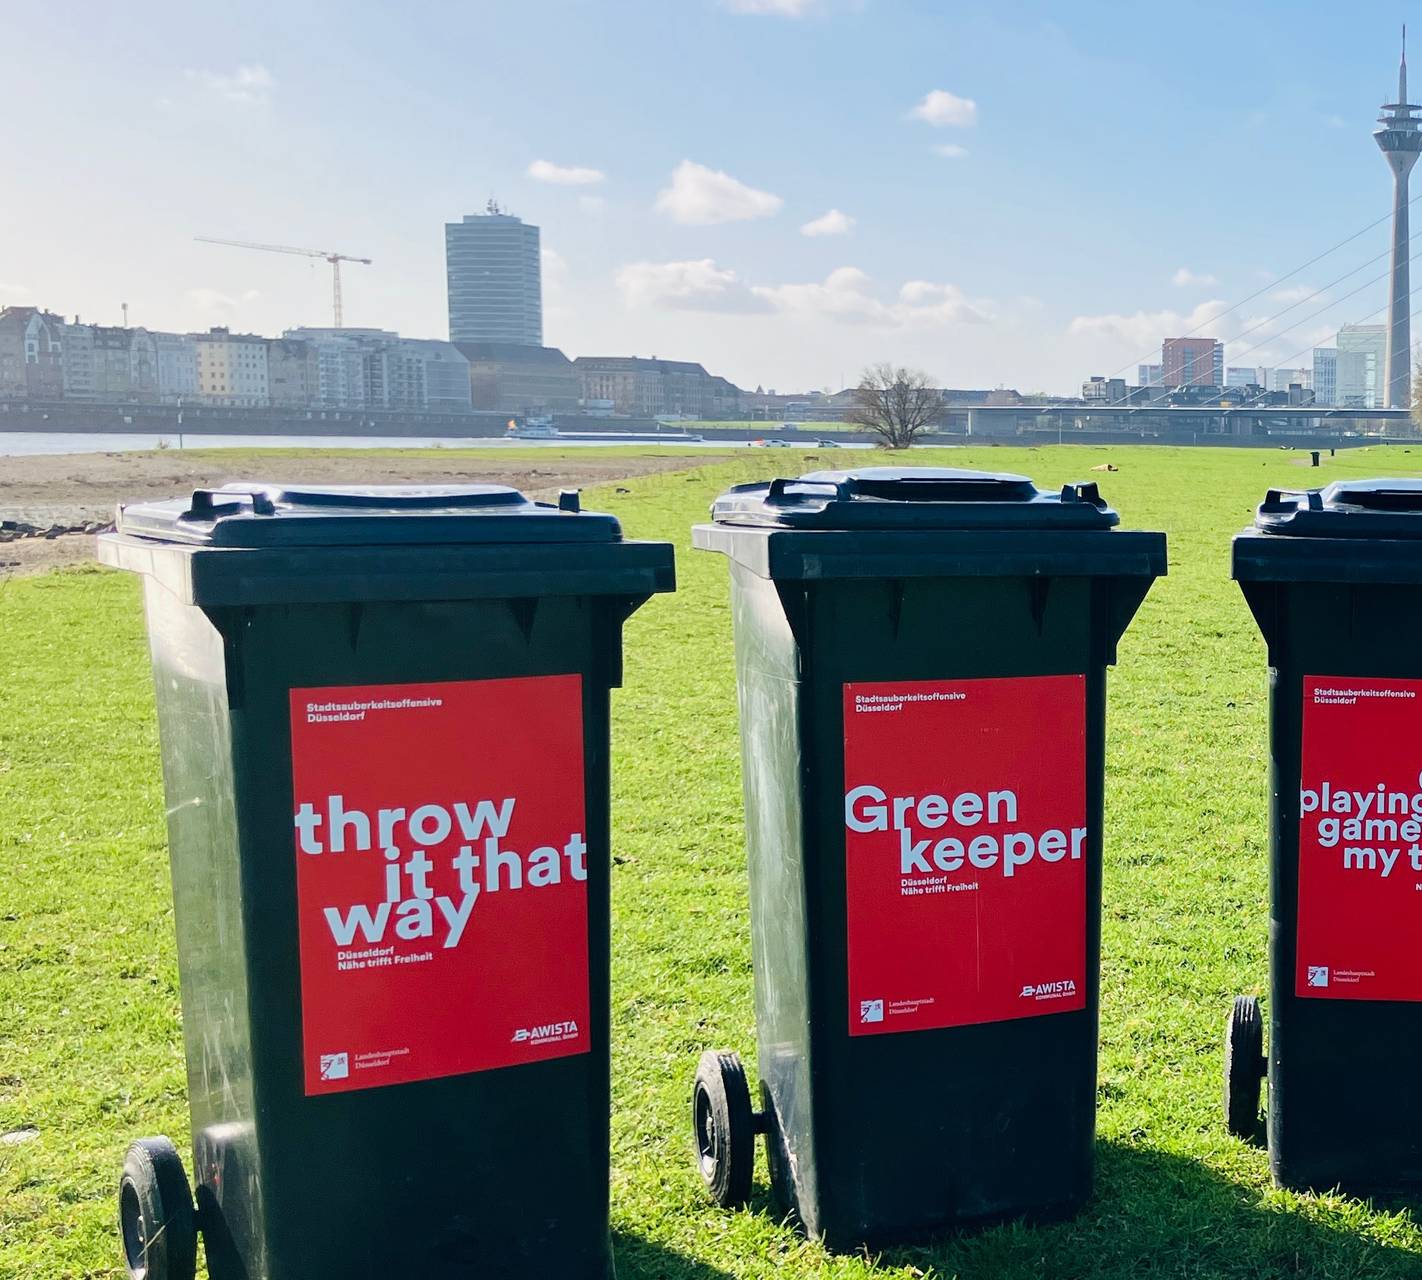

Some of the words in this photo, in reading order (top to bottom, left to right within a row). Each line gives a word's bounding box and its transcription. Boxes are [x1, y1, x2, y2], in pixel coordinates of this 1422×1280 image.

[856, 692, 966, 703] Stadtsauberkeitsoffensive
[1314, 688, 1415, 697] Stadtsauberkeitsoffensive
[307, 699, 442, 712] Stadtsauberkeitsoffensive
[1314, 696, 1356, 704] Düsseldorf
[856, 702, 903, 712] Düsseldorf
[307, 711, 365, 723] Düsseldorf
[845, 785, 1017, 833] Green
[294, 795, 515, 854] throw
[901, 826, 1087, 877] keeper
[386, 845, 433, 903] it
[453, 833, 587, 896] that
[1344, 847, 1400, 877] my
[901, 875, 947, 886] Düsseldorf
[901, 886, 924, 895] Nähe
[925, 884, 945, 894] trifft
[947, 882, 978, 892] Freiheit
[324, 890, 480, 948] way
[338, 946, 394, 960] Düsseldorf
[338, 959, 365, 970] Nähe
[367, 956, 392, 967] trifft
[394, 952, 433, 964] Freiheit
[1036, 981, 1075, 994] AWISTA
[531, 1021, 578, 1039] AWISTA
[355, 1047, 409, 1061] Landeshauptstadt
[355, 1059, 390, 1069] Düsseldorf
